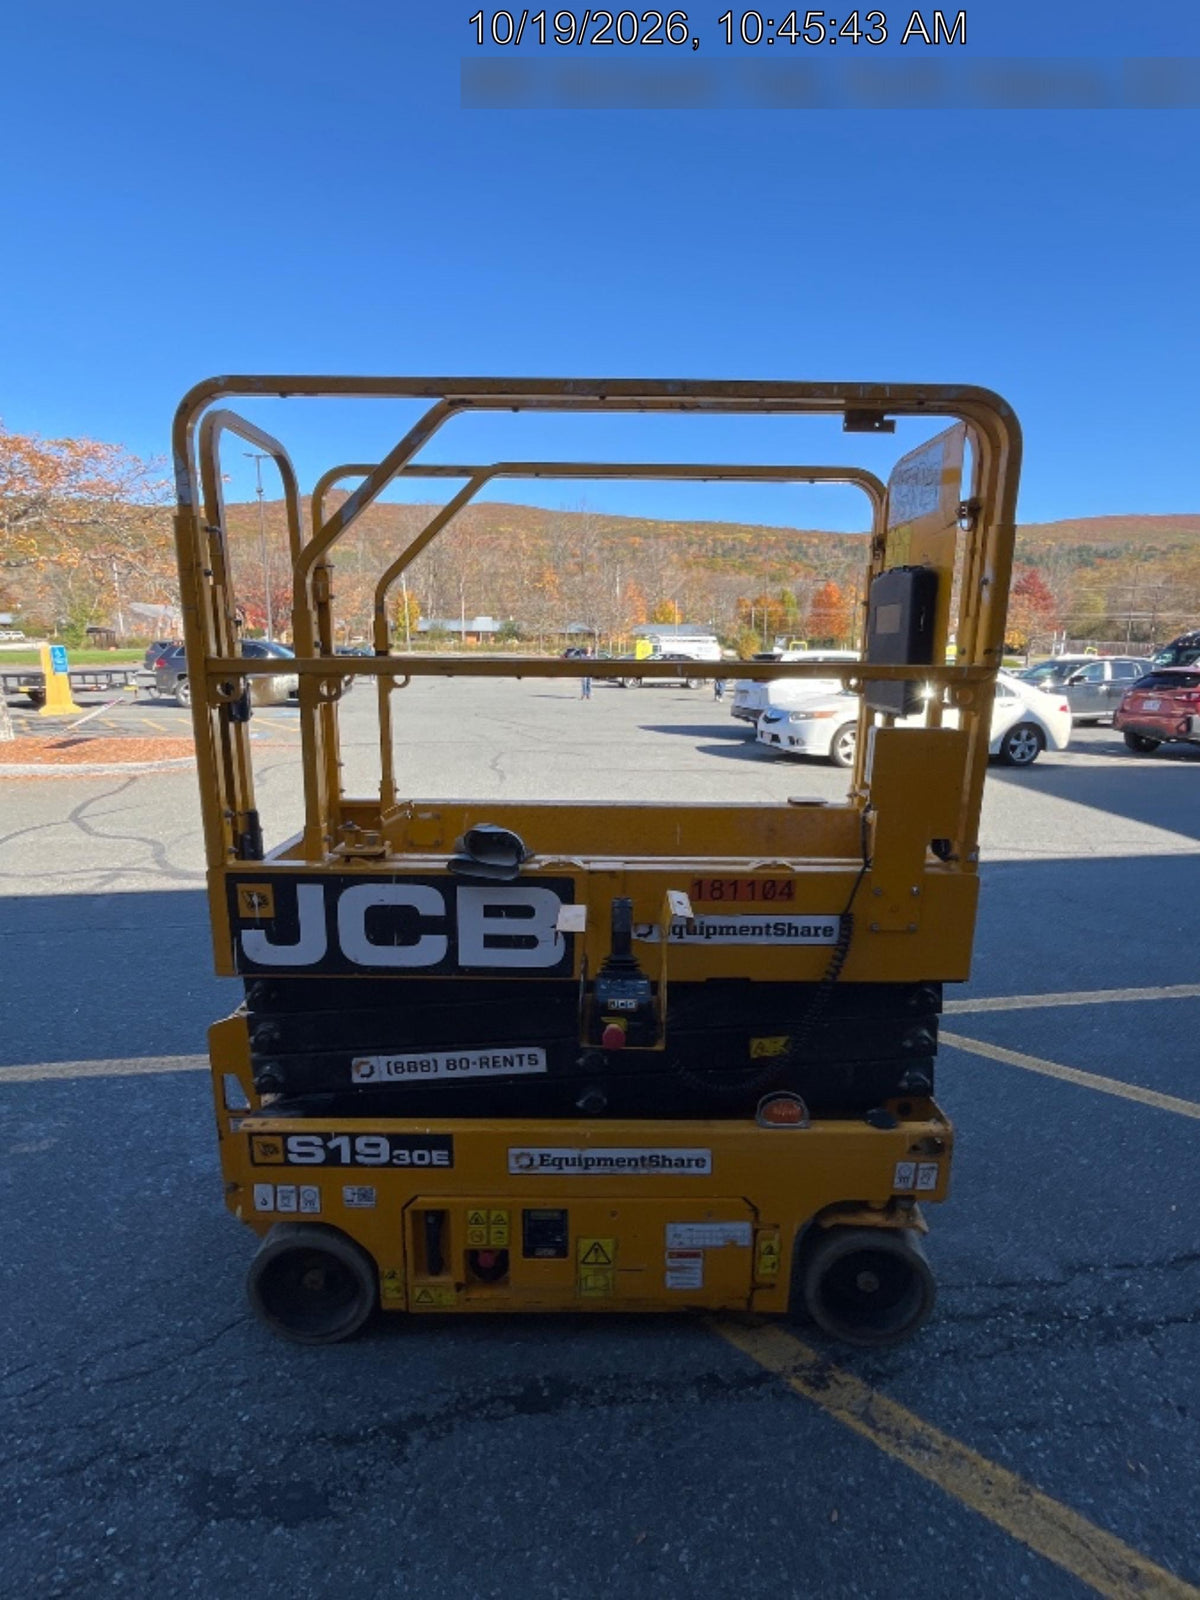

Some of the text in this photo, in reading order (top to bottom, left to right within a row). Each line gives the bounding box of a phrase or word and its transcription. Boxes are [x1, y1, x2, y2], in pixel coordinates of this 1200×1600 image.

[693, 879, 795, 901] 181104
[241, 883, 566, 968] JCB
[667, 922, 835, 939] quipmentShare
[538, 1153, 707, 1171] EquipmentShare
